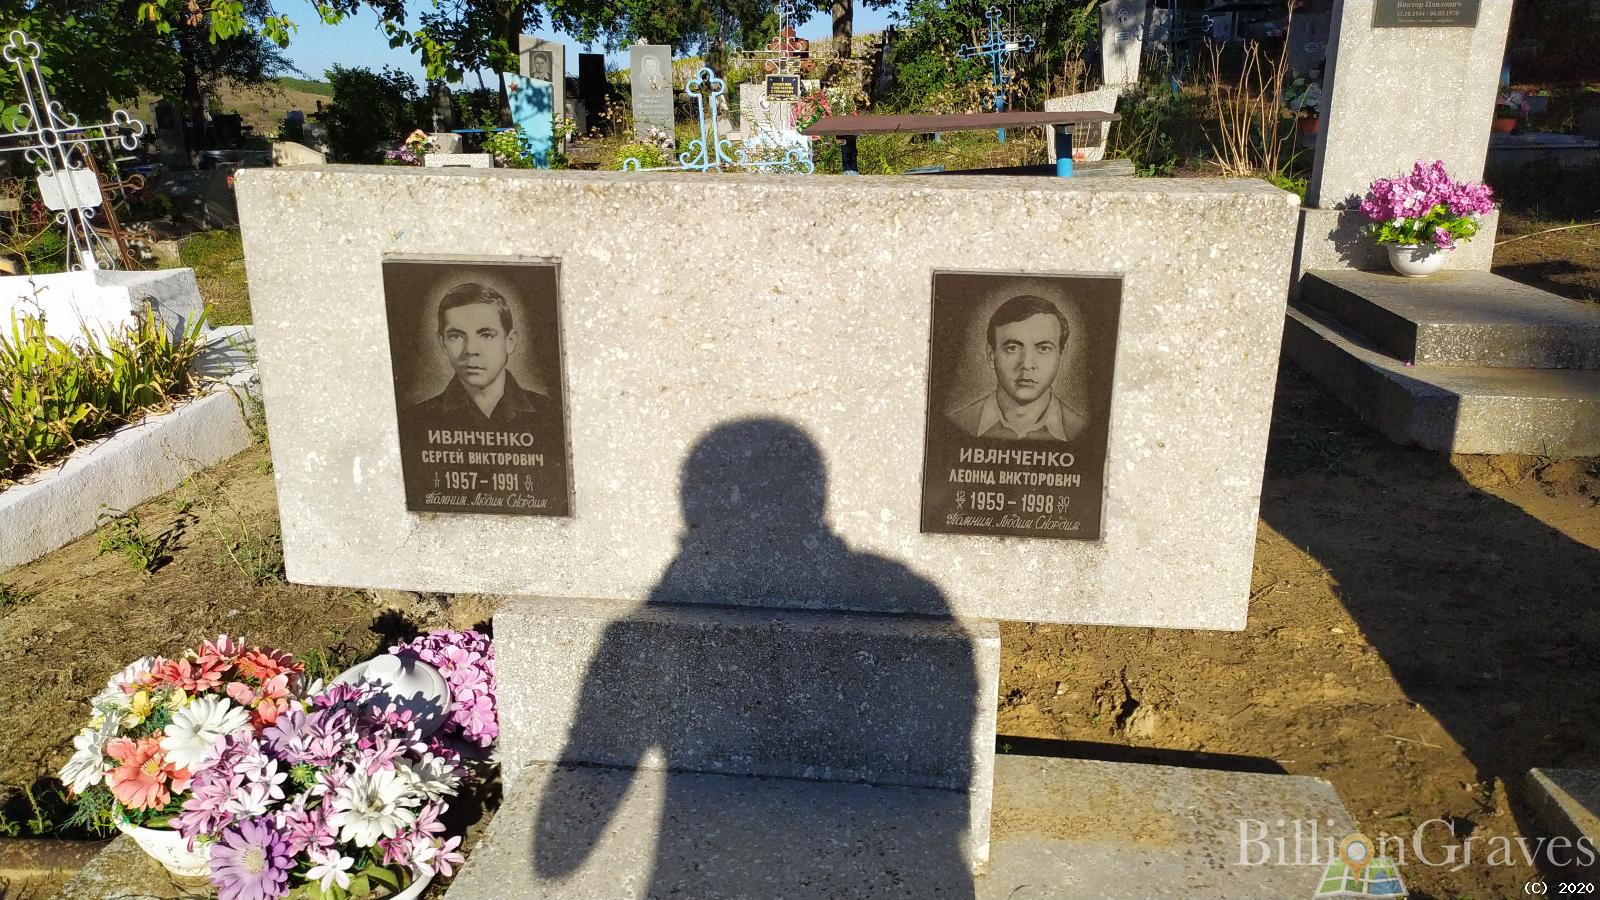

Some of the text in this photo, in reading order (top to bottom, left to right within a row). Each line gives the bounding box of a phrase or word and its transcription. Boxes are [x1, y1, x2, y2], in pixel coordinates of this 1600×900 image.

[428, 429, 534, 447] ИВАНЧЕНКО
[422, 448, 544, 467] СЕРГЕЙ ВИКТОРОВИЧ
[959, 447, 1075, 468] ИВАНЧЕНКО
[949, 468, 1081, 488] ЛЕОНИД ВИКТОРОВИЧ
